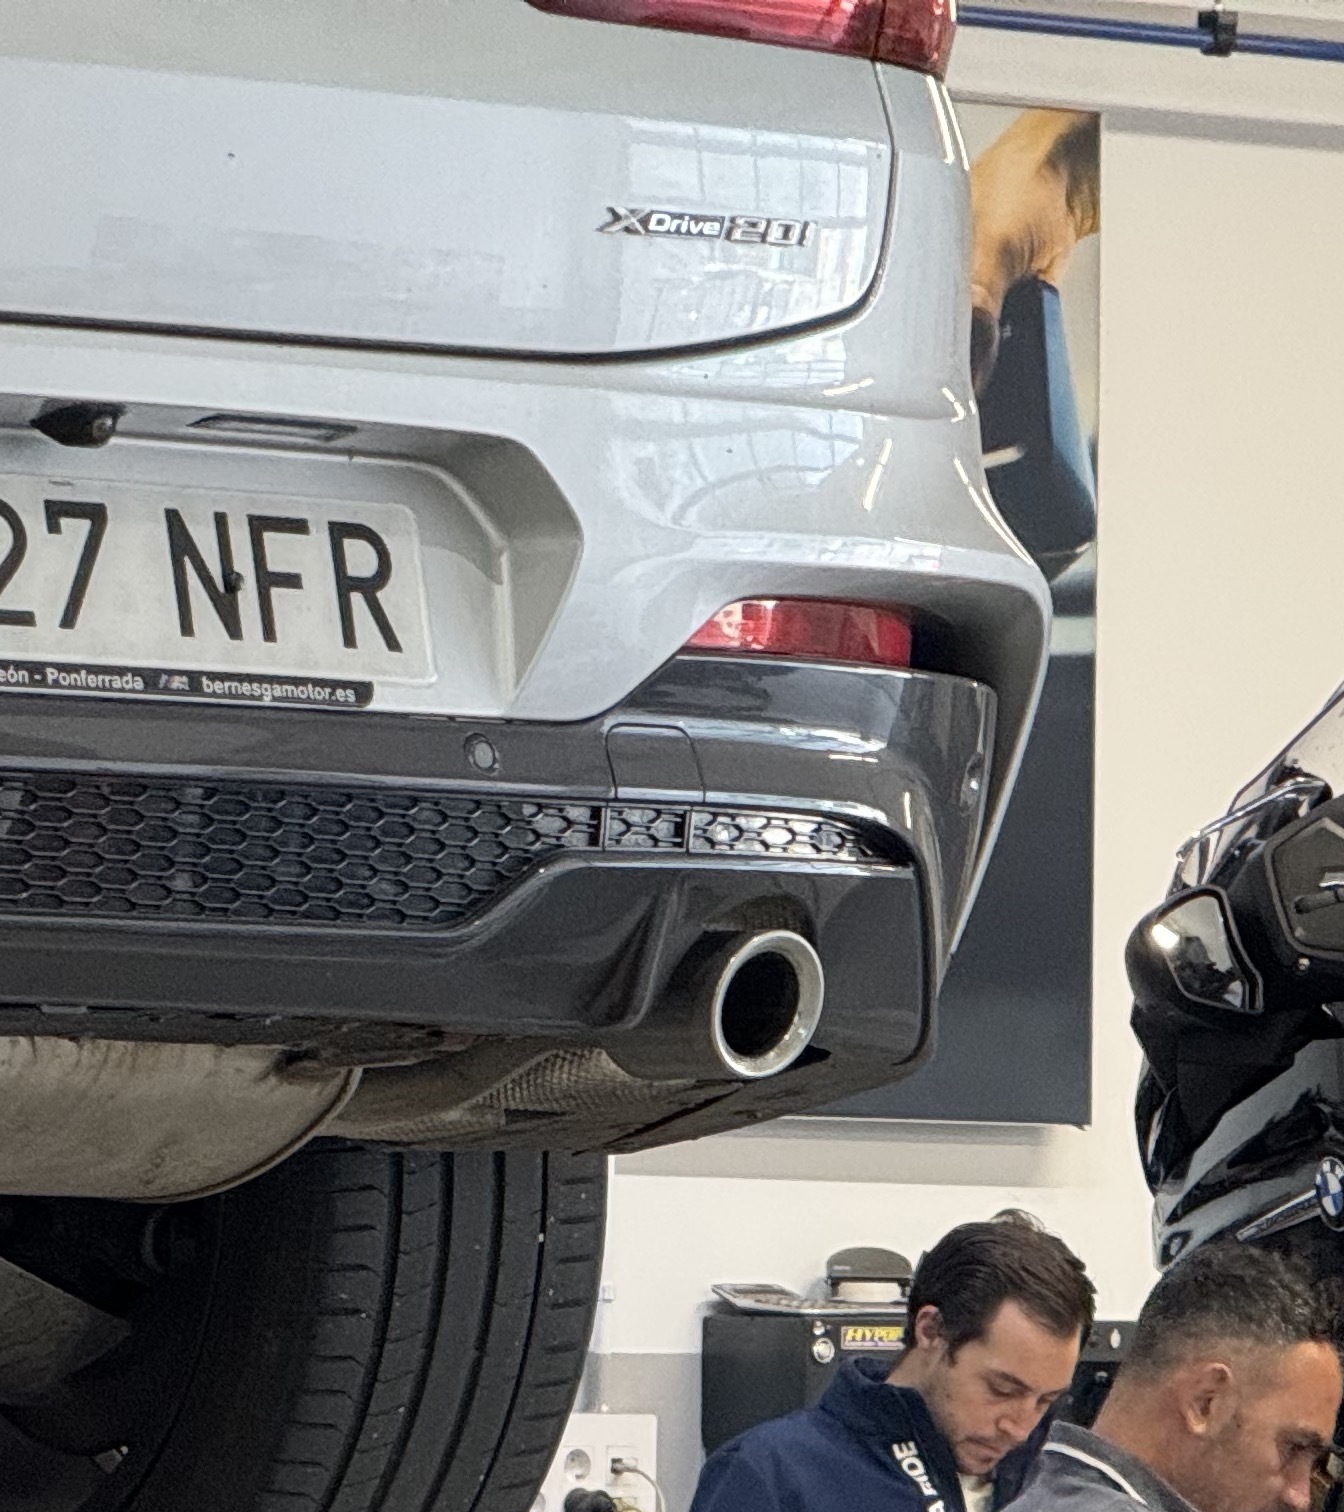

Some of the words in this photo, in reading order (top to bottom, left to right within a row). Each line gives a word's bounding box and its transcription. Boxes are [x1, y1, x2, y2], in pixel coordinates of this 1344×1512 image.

[163, 506, 403, 654] NFR
[46, 667, 145, 690] Ponferrada
[201, 675, 356, 702] bernesgamotor.es
